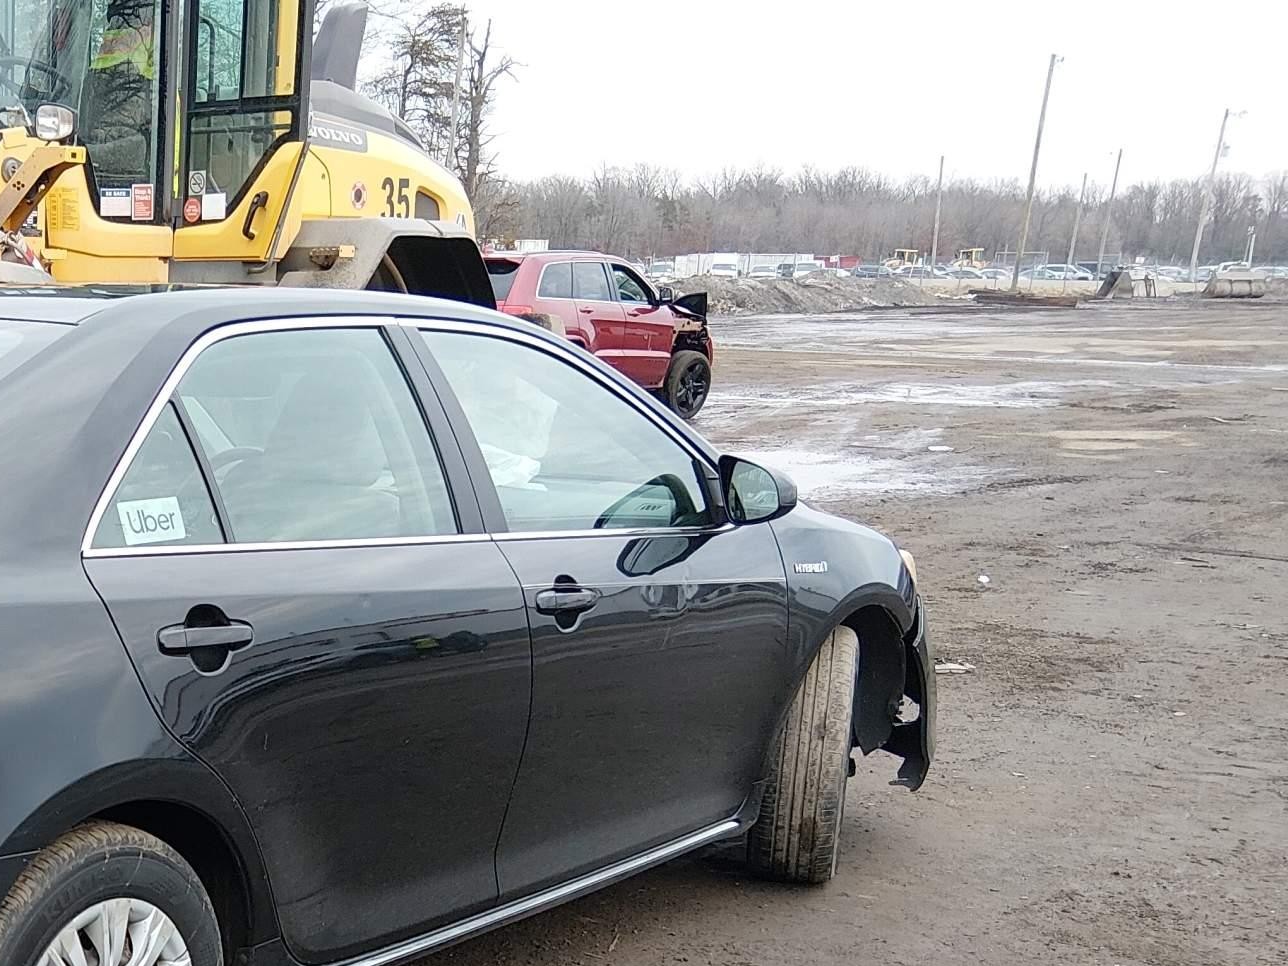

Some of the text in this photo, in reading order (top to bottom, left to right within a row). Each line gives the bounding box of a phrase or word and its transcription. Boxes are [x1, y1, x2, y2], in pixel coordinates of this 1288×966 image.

[309, 126, 363, 145] VOLVO
[380, 176, 410, 219] 35
[125, 509, 175, 534] Uber
